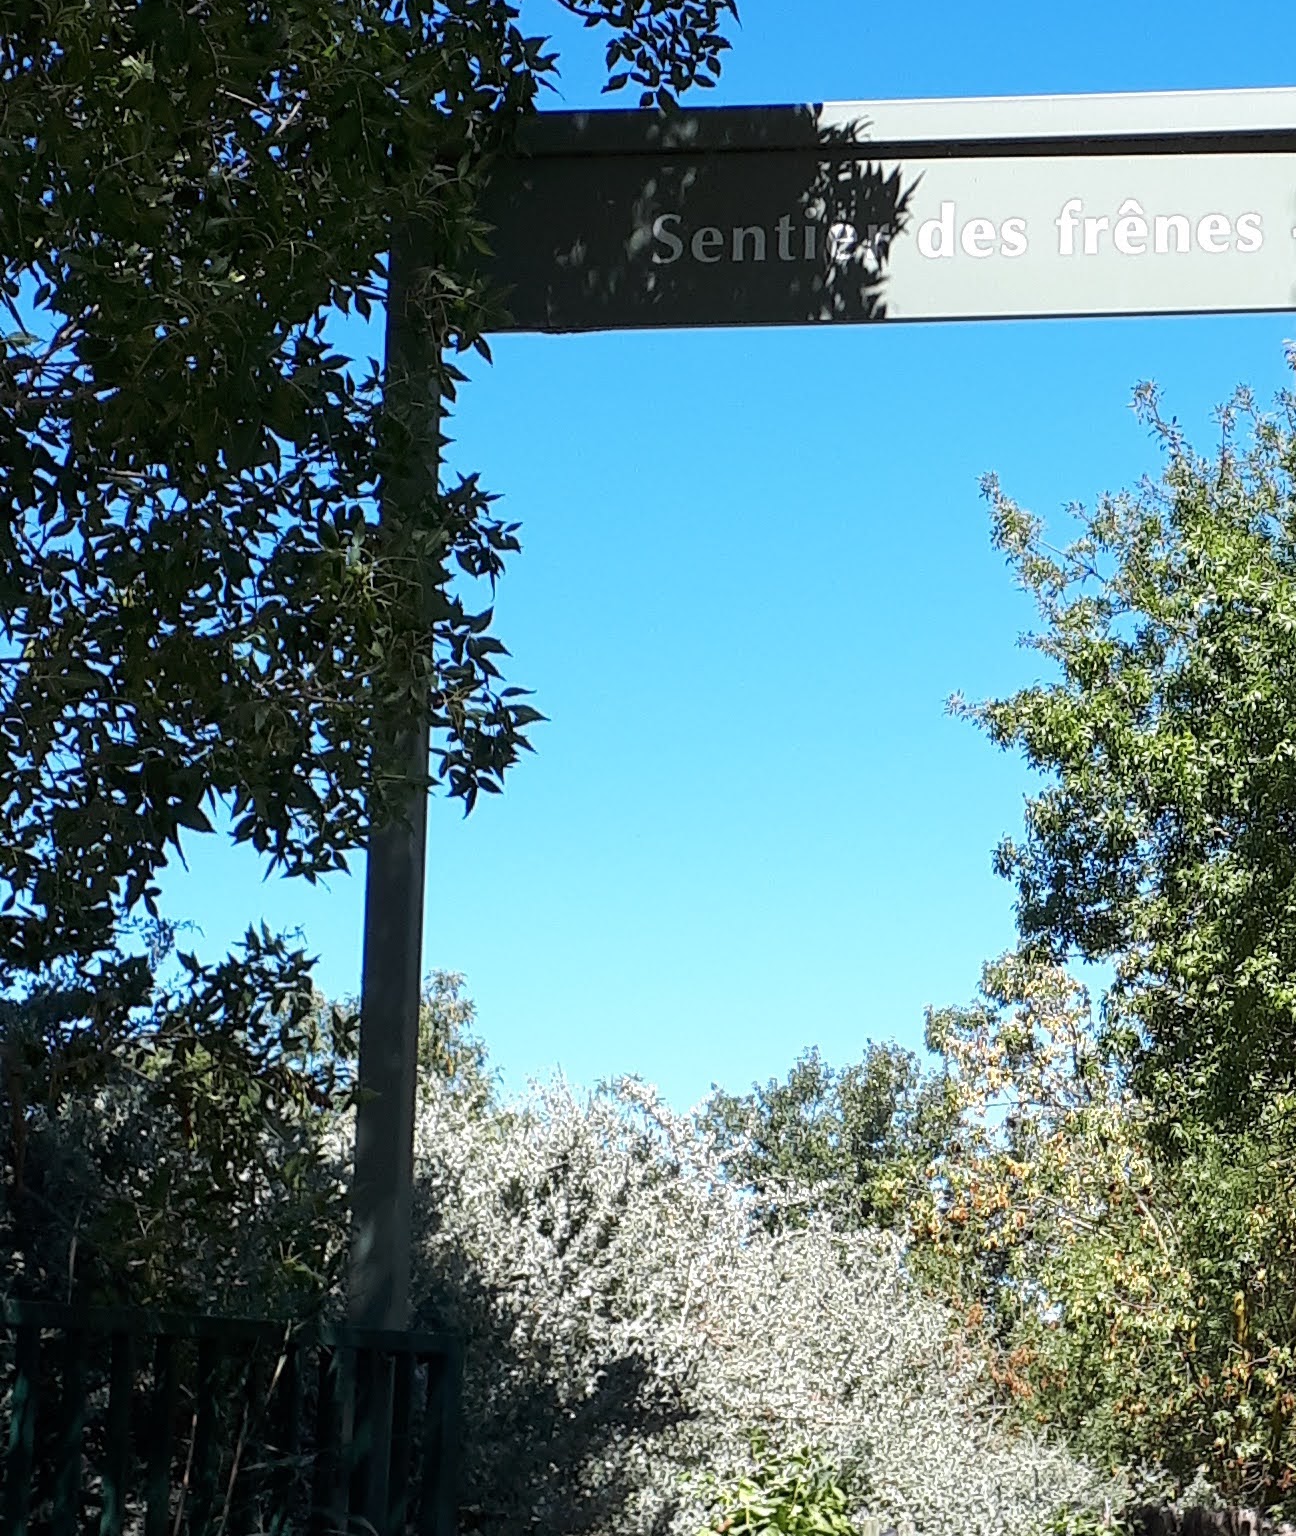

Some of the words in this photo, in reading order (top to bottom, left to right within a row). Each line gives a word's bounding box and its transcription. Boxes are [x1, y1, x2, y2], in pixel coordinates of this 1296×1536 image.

[652, 206, 891, 264] Sentier
[917, 201, 1028, 259] des
[1056, 199, 1264, 256] frênes
